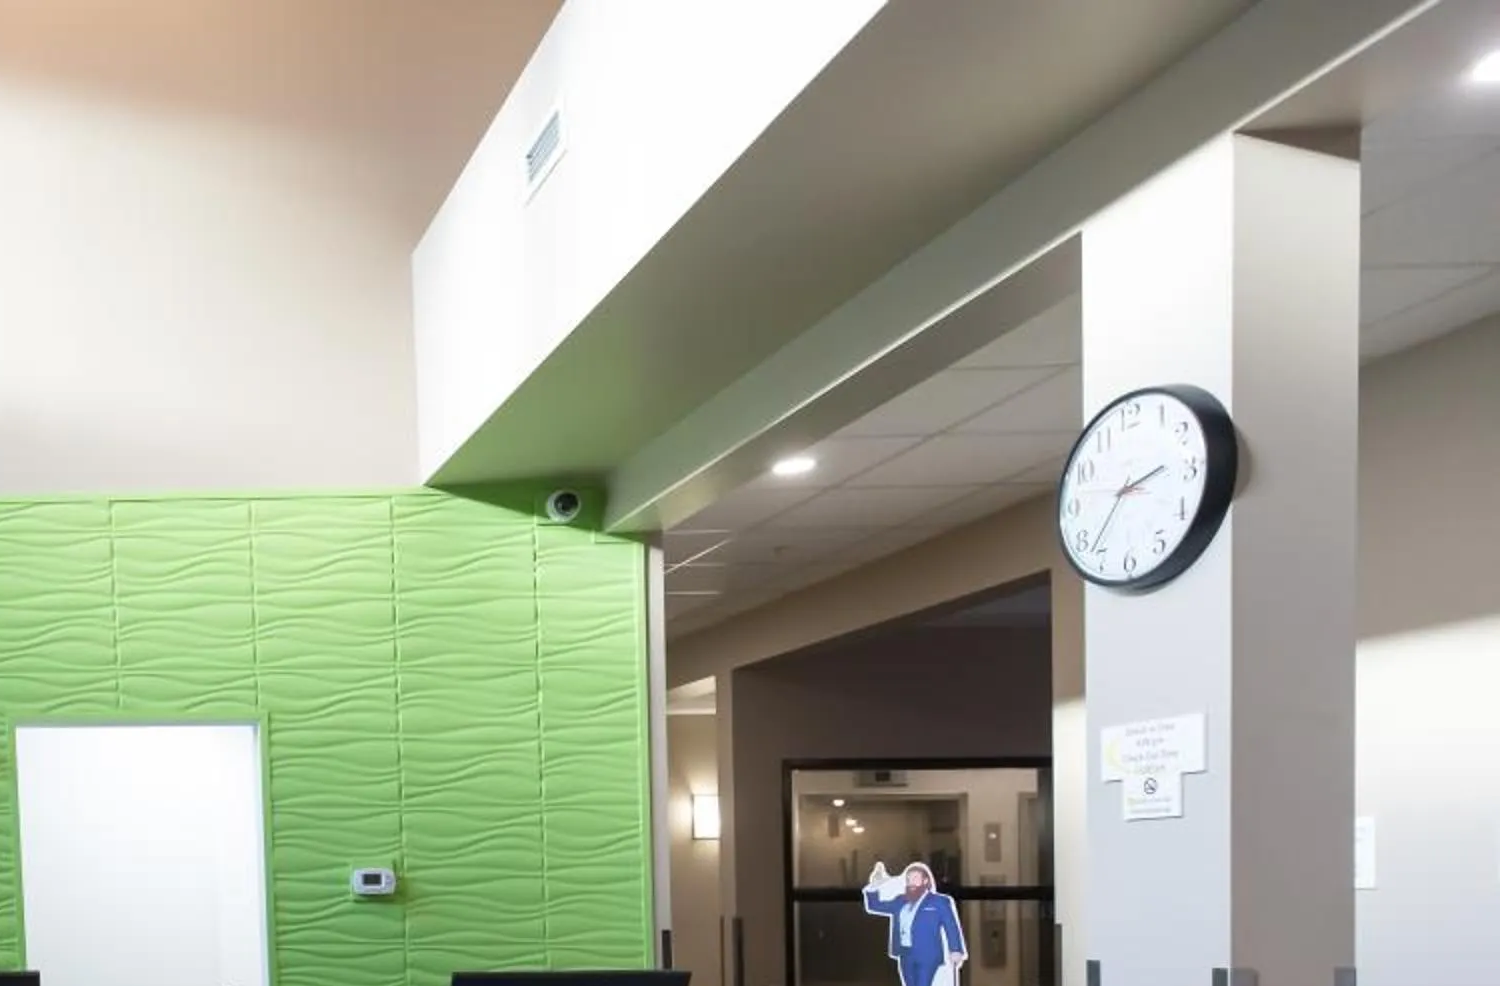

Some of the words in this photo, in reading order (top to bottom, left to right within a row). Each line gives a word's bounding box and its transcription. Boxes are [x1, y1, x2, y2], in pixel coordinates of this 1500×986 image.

[1120, 401, 1141, 433] 12
[1098, 427, 1112, 453] 11
[1175, 421, 1189, 446] 2
[1077, 458, 1095, 486] 10
[1184, 457, 1198, 481] 3
[1067, 498, 1081, 520] 9
[1174, 495, 1188, 521] 4
[1076, 529, 1090, 553] 8
[1153, 530, 1167, 555] 5
[1124, 551, 1136, 573] 6
